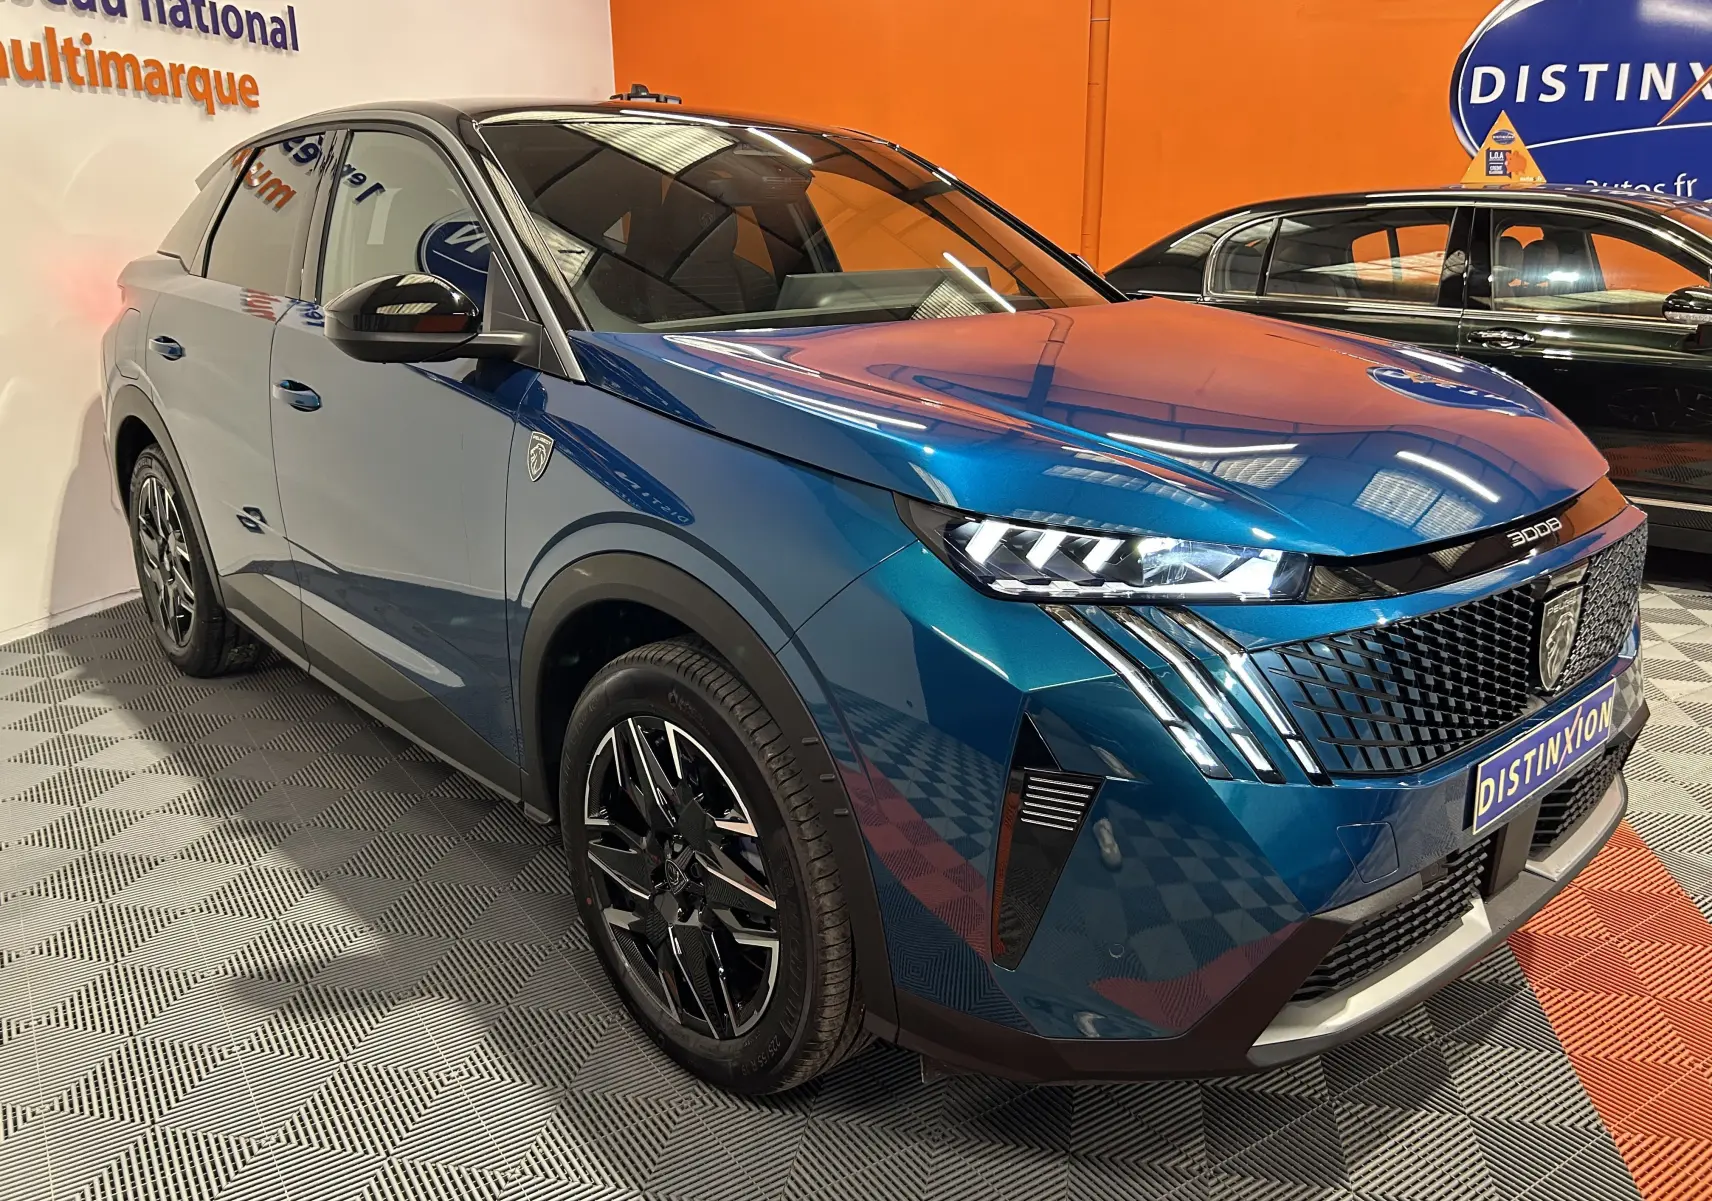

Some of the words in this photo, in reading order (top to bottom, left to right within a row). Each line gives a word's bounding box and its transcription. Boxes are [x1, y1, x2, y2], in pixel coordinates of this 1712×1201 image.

[139, 0, 299, 51] national
[0, 26, 260, 116] ultimarque
[1507, 517, 1562, 548] 3008
[1478, 696, 1613, 817] DISTINXION
